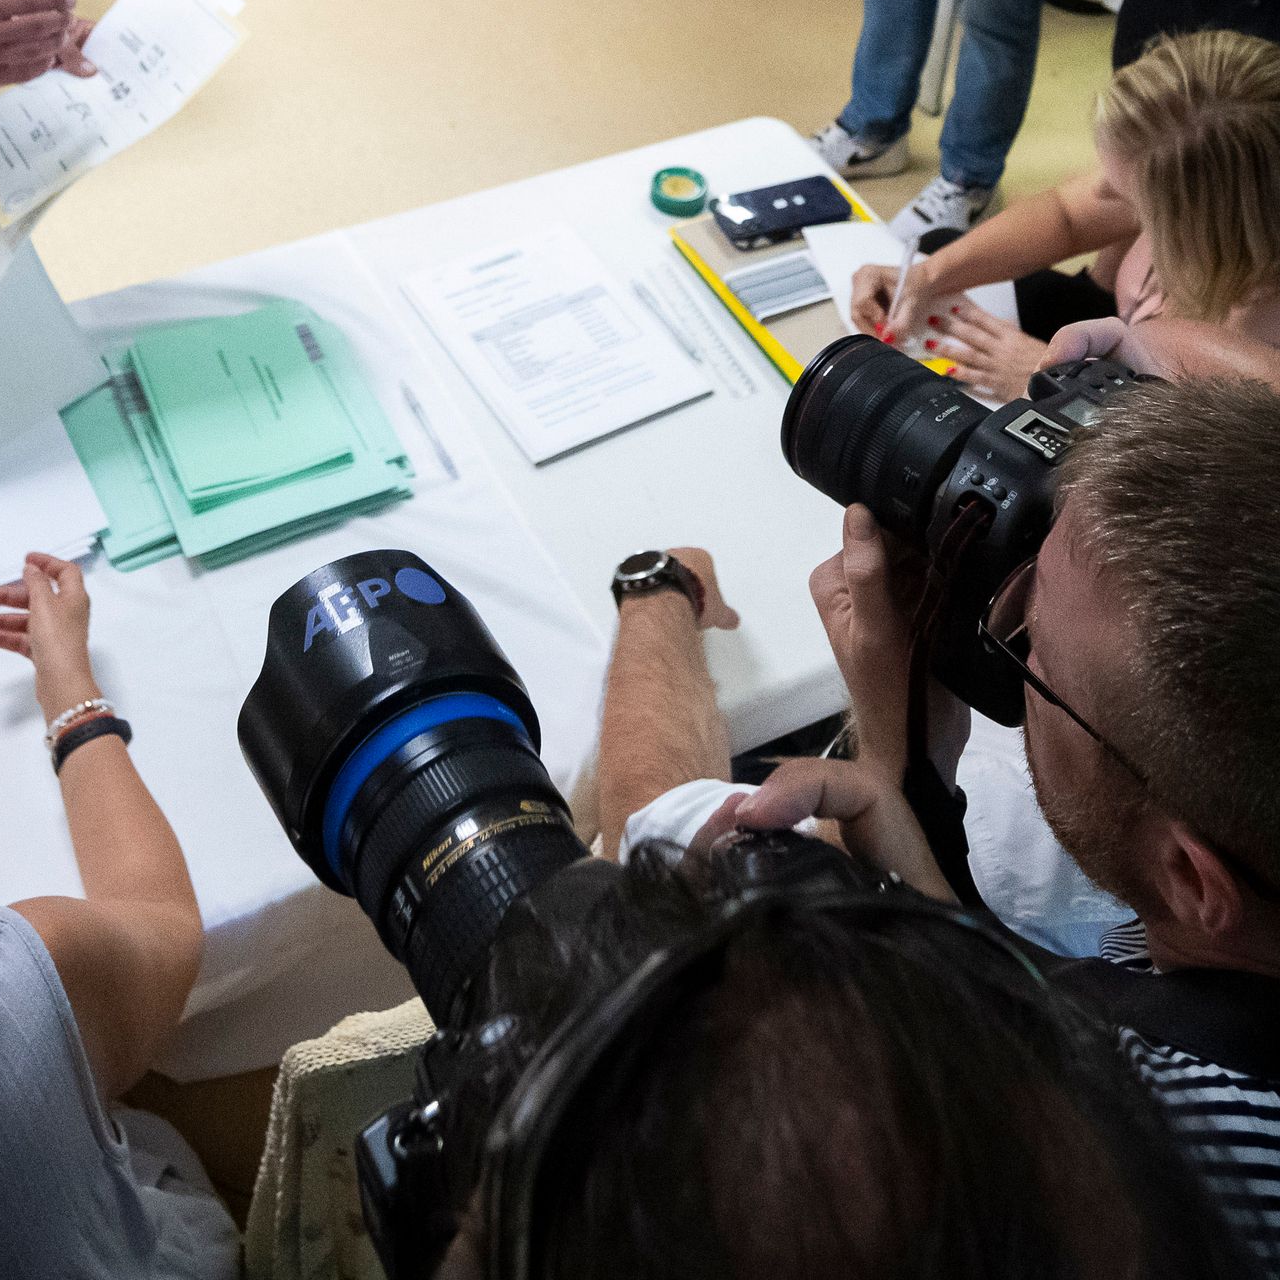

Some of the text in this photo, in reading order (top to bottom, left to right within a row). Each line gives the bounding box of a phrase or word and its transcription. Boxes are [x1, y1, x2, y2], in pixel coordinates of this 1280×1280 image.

[935, 405, 961, 423] Canon
[303, 577, 392, 653] AFP
[421, 836, 453, 872] Nikon
